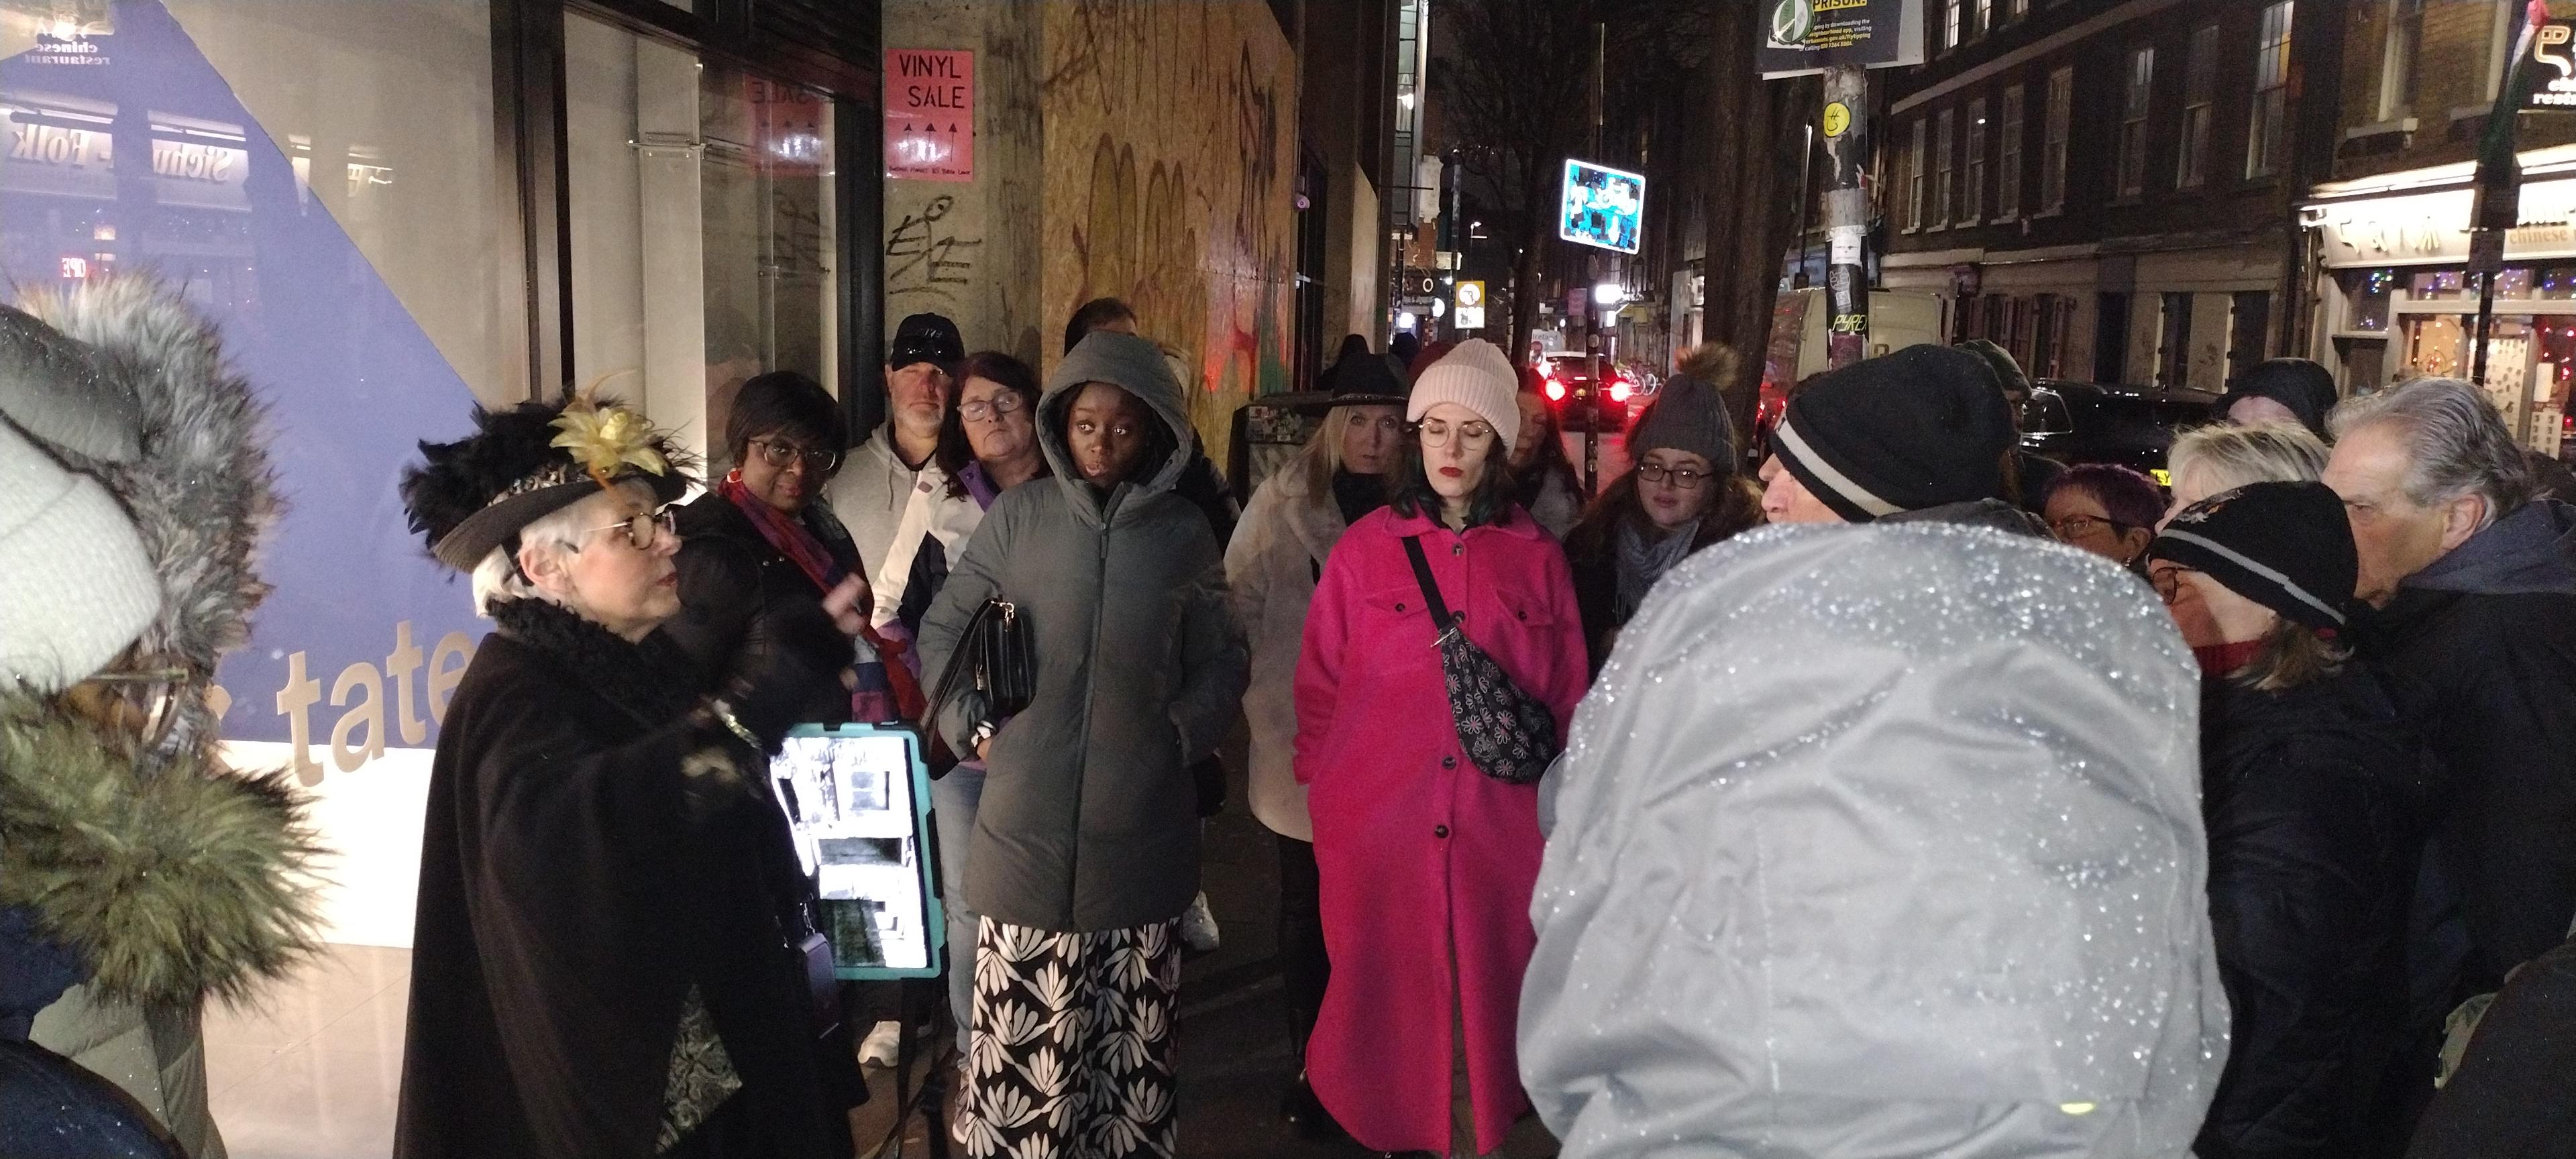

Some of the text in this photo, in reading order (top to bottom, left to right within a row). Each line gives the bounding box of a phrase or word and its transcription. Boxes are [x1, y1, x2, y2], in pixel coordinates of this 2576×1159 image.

[1813, 0, 1866, 9] PRISON
[899, 54, 961, 78] VINYL
[908, 85, 966, 109] SALE
[2509, 227, 2568, 245] chinese
[276, 620, 478, 787] tate
